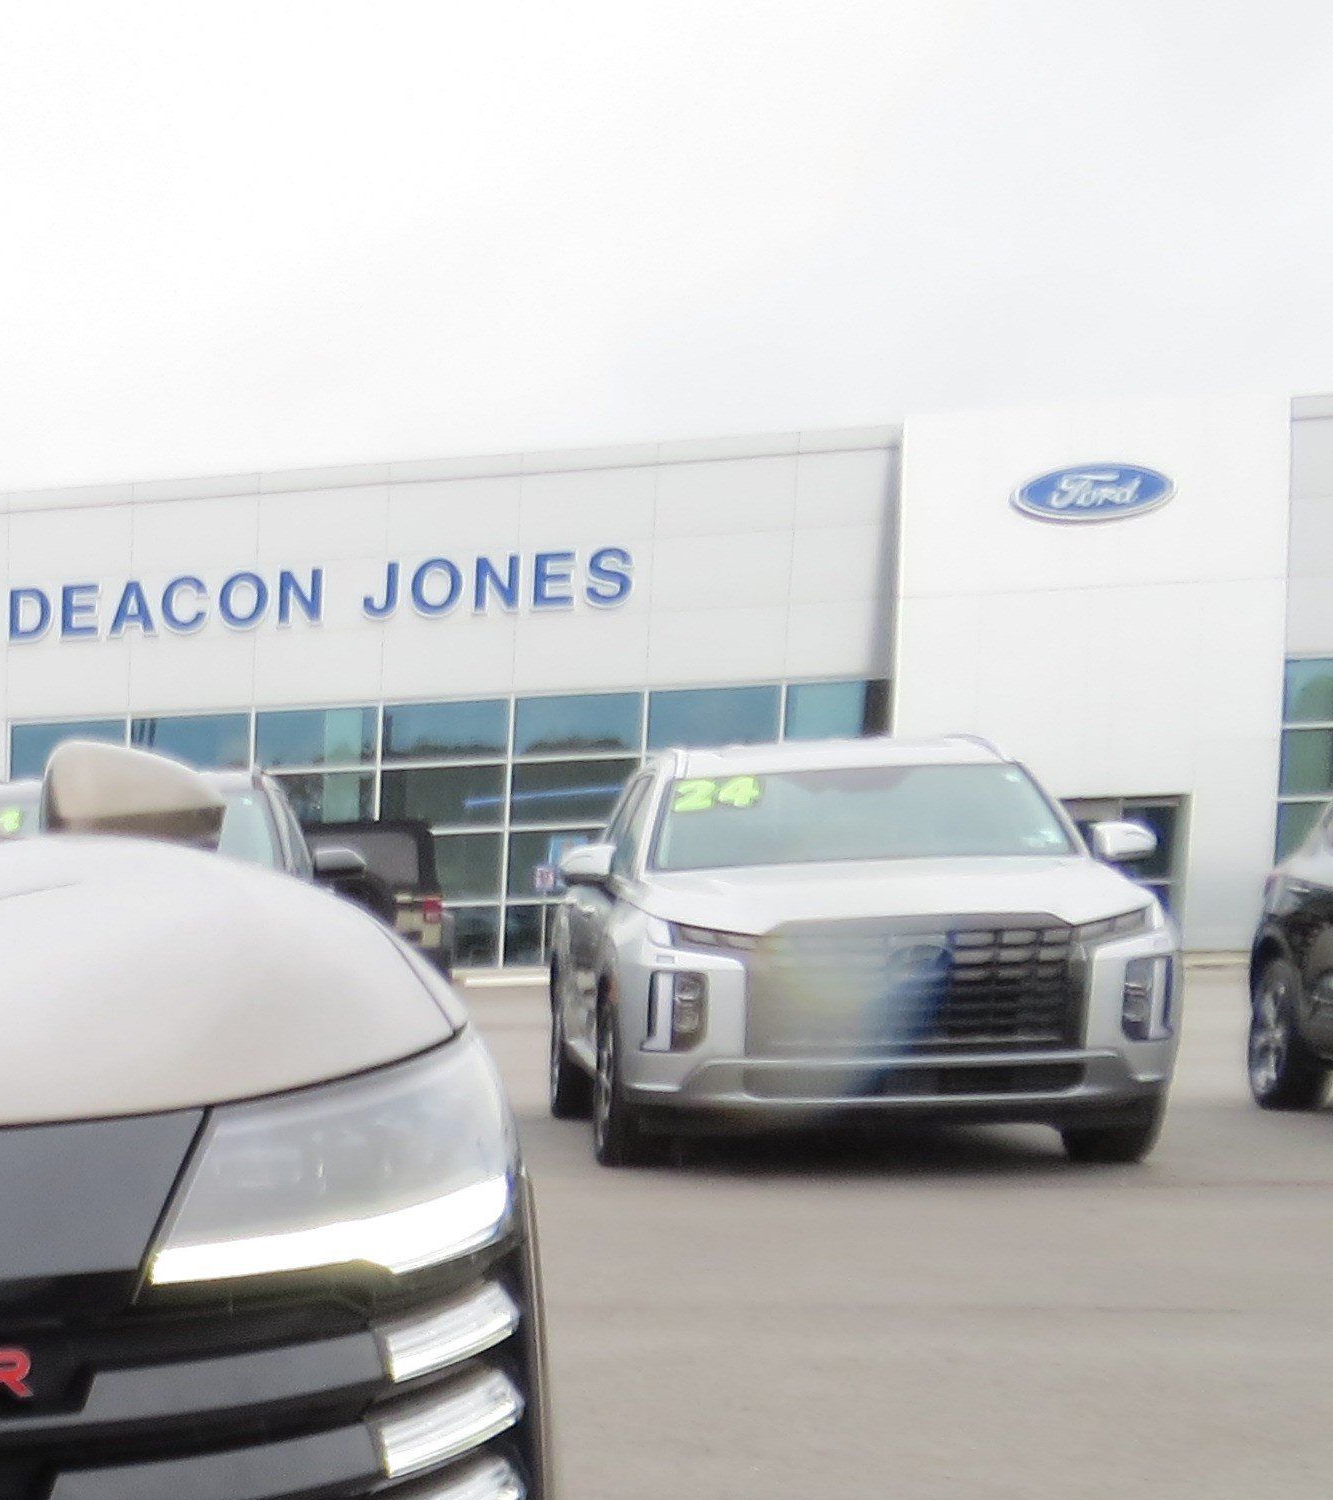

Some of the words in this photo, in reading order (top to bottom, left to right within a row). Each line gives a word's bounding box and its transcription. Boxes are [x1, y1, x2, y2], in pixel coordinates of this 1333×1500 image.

[1050, 470, 1142, 509] Ford
[6, 566, 324, 644] DEACON
[362, 546, 634, 619] JONES
[673, 775, 761, 813] 24
